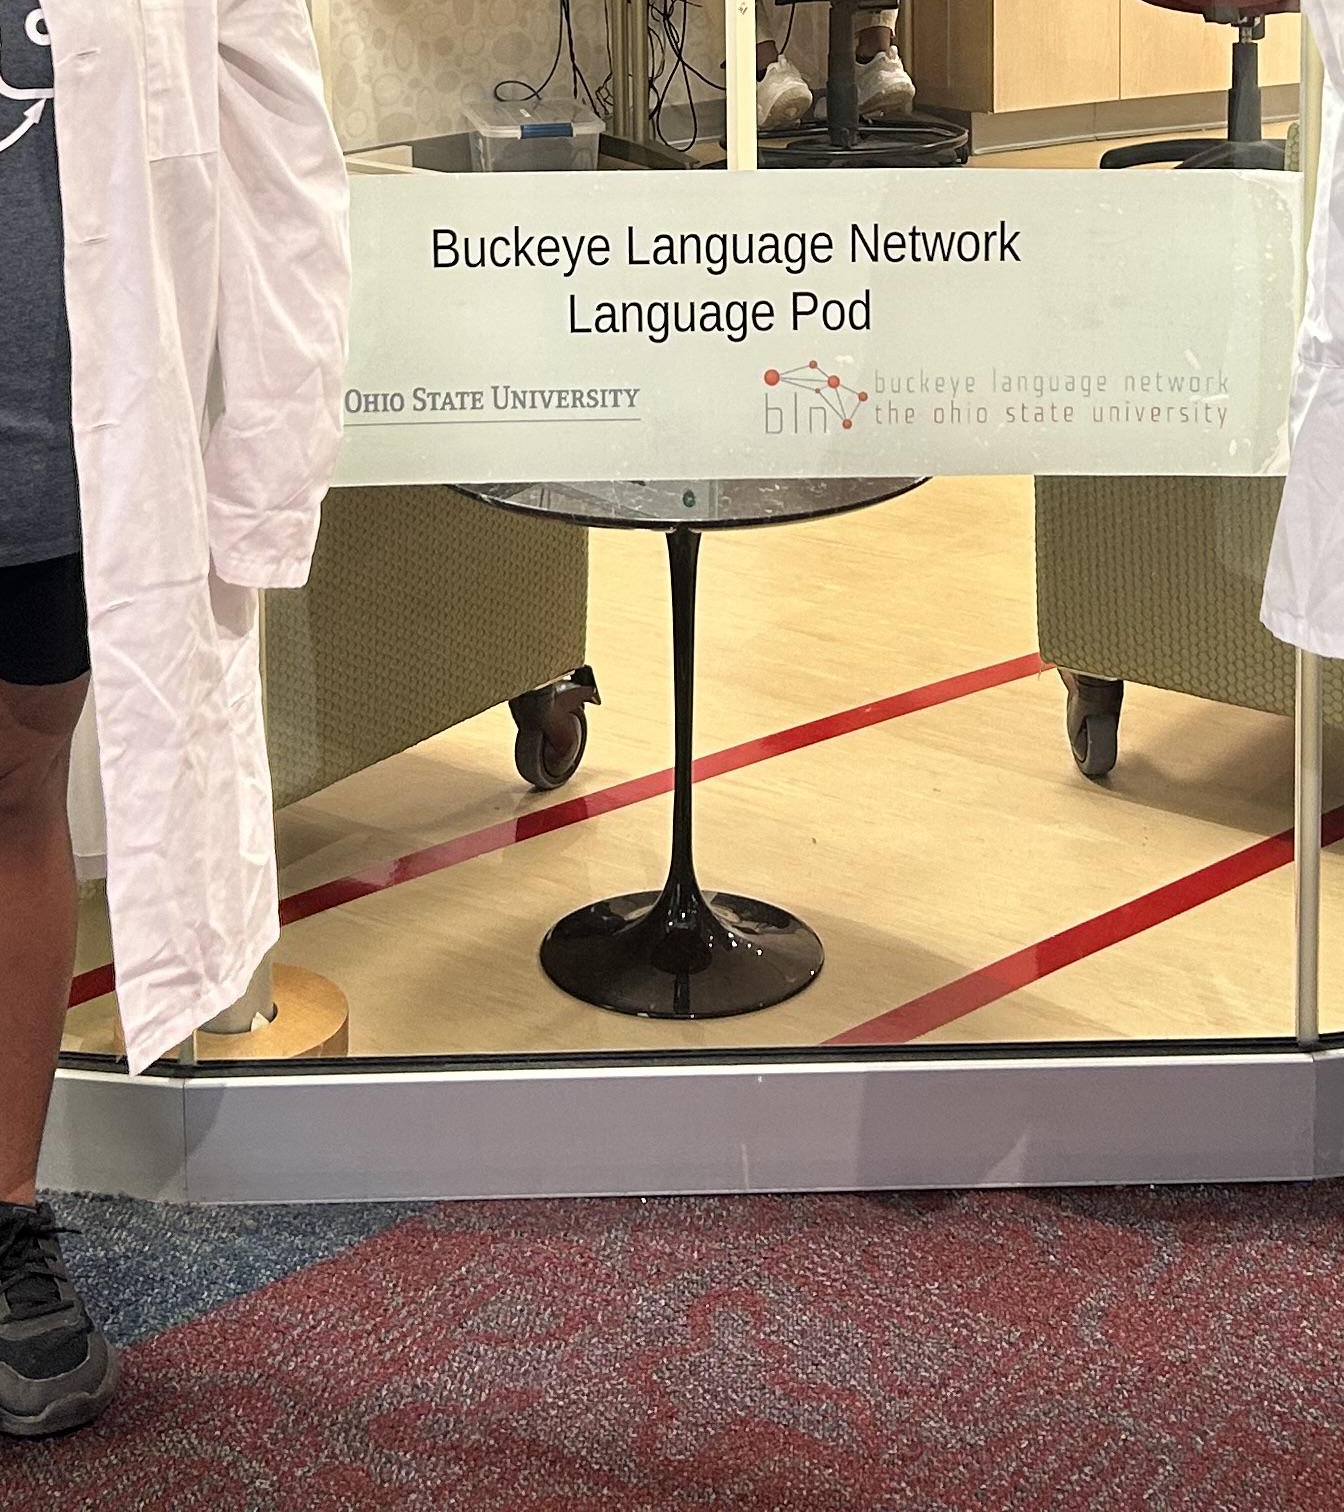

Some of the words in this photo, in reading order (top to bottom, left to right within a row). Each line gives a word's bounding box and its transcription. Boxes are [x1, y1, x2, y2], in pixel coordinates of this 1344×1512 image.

[431, 226, 611, 278] Buckeye
[626, 225, 834, 275] Language
[850, 220, 1022, 263] Network
[568, 293, 776, 343] Language
[791, 289, 872, 332] Pod
[344, 387, 405, 414] OHIO
[412, 386, 485, 412] STATE
[491, 385, 641, 411] UNIVERSITY
[874, 369, 977, 398] buckeye
[992, 367, 1108, 398] language
[1124, 367, 1230, 393] network
[764, 391, 829, 434] bln
[875, 400, 916, 425] the
[932, 399, 989, 425] ohio
[1006, 400, 1075, 424] state
[1092, 399, 1229, 429] university
